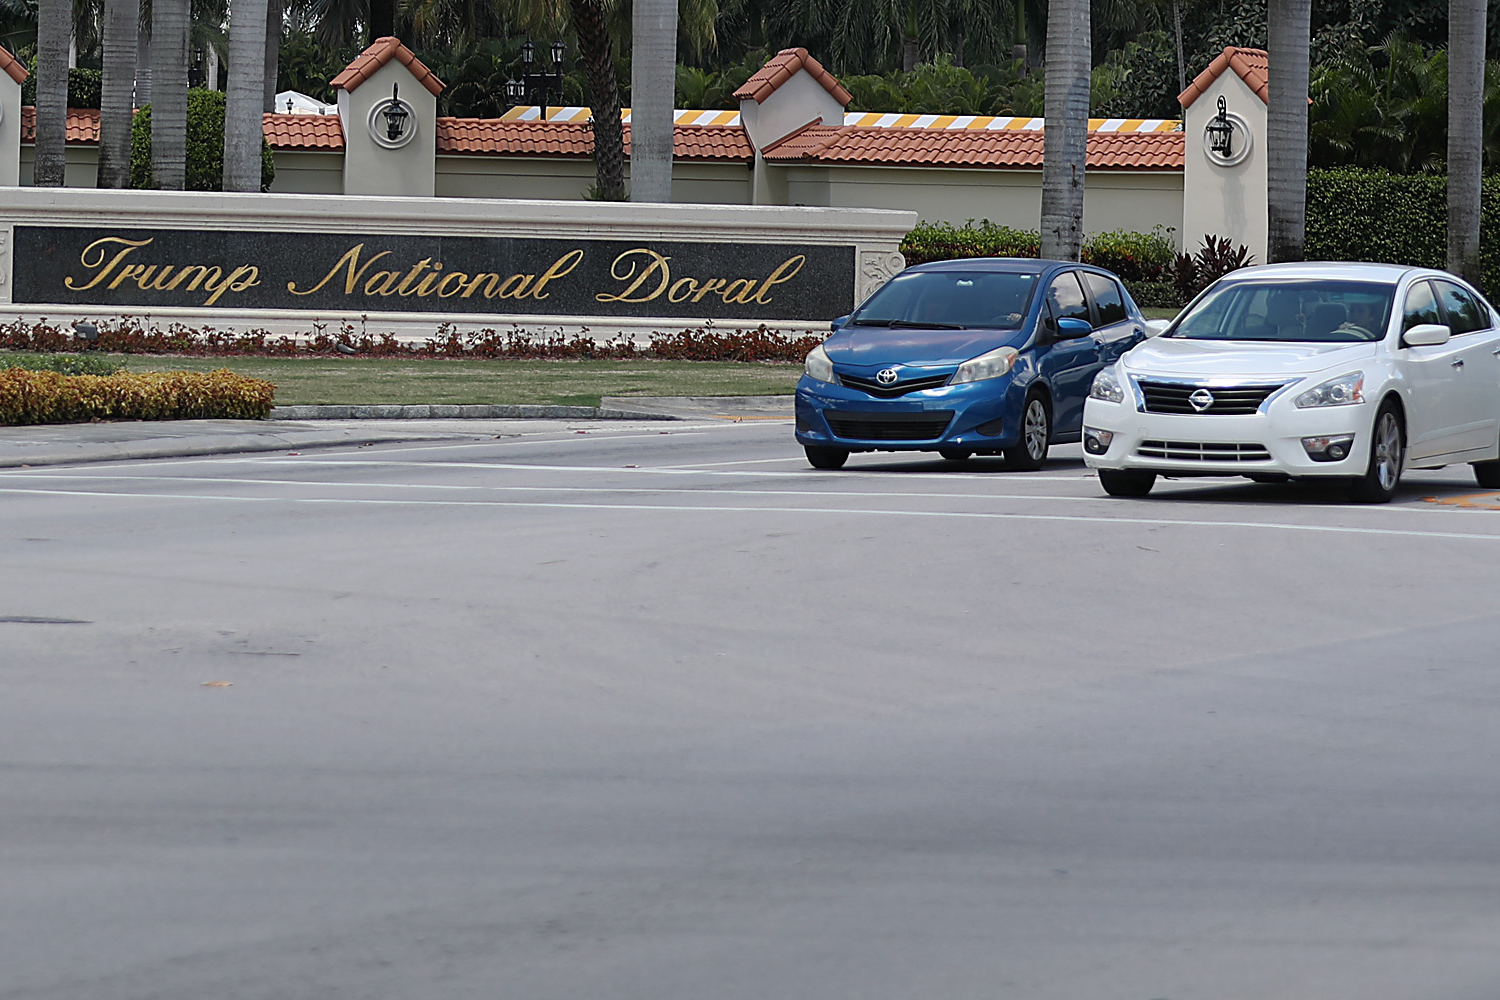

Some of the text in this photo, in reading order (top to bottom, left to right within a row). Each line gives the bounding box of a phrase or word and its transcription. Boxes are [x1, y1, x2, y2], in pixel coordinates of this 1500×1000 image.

[64, 236, 806, 305] Trump National Doral
